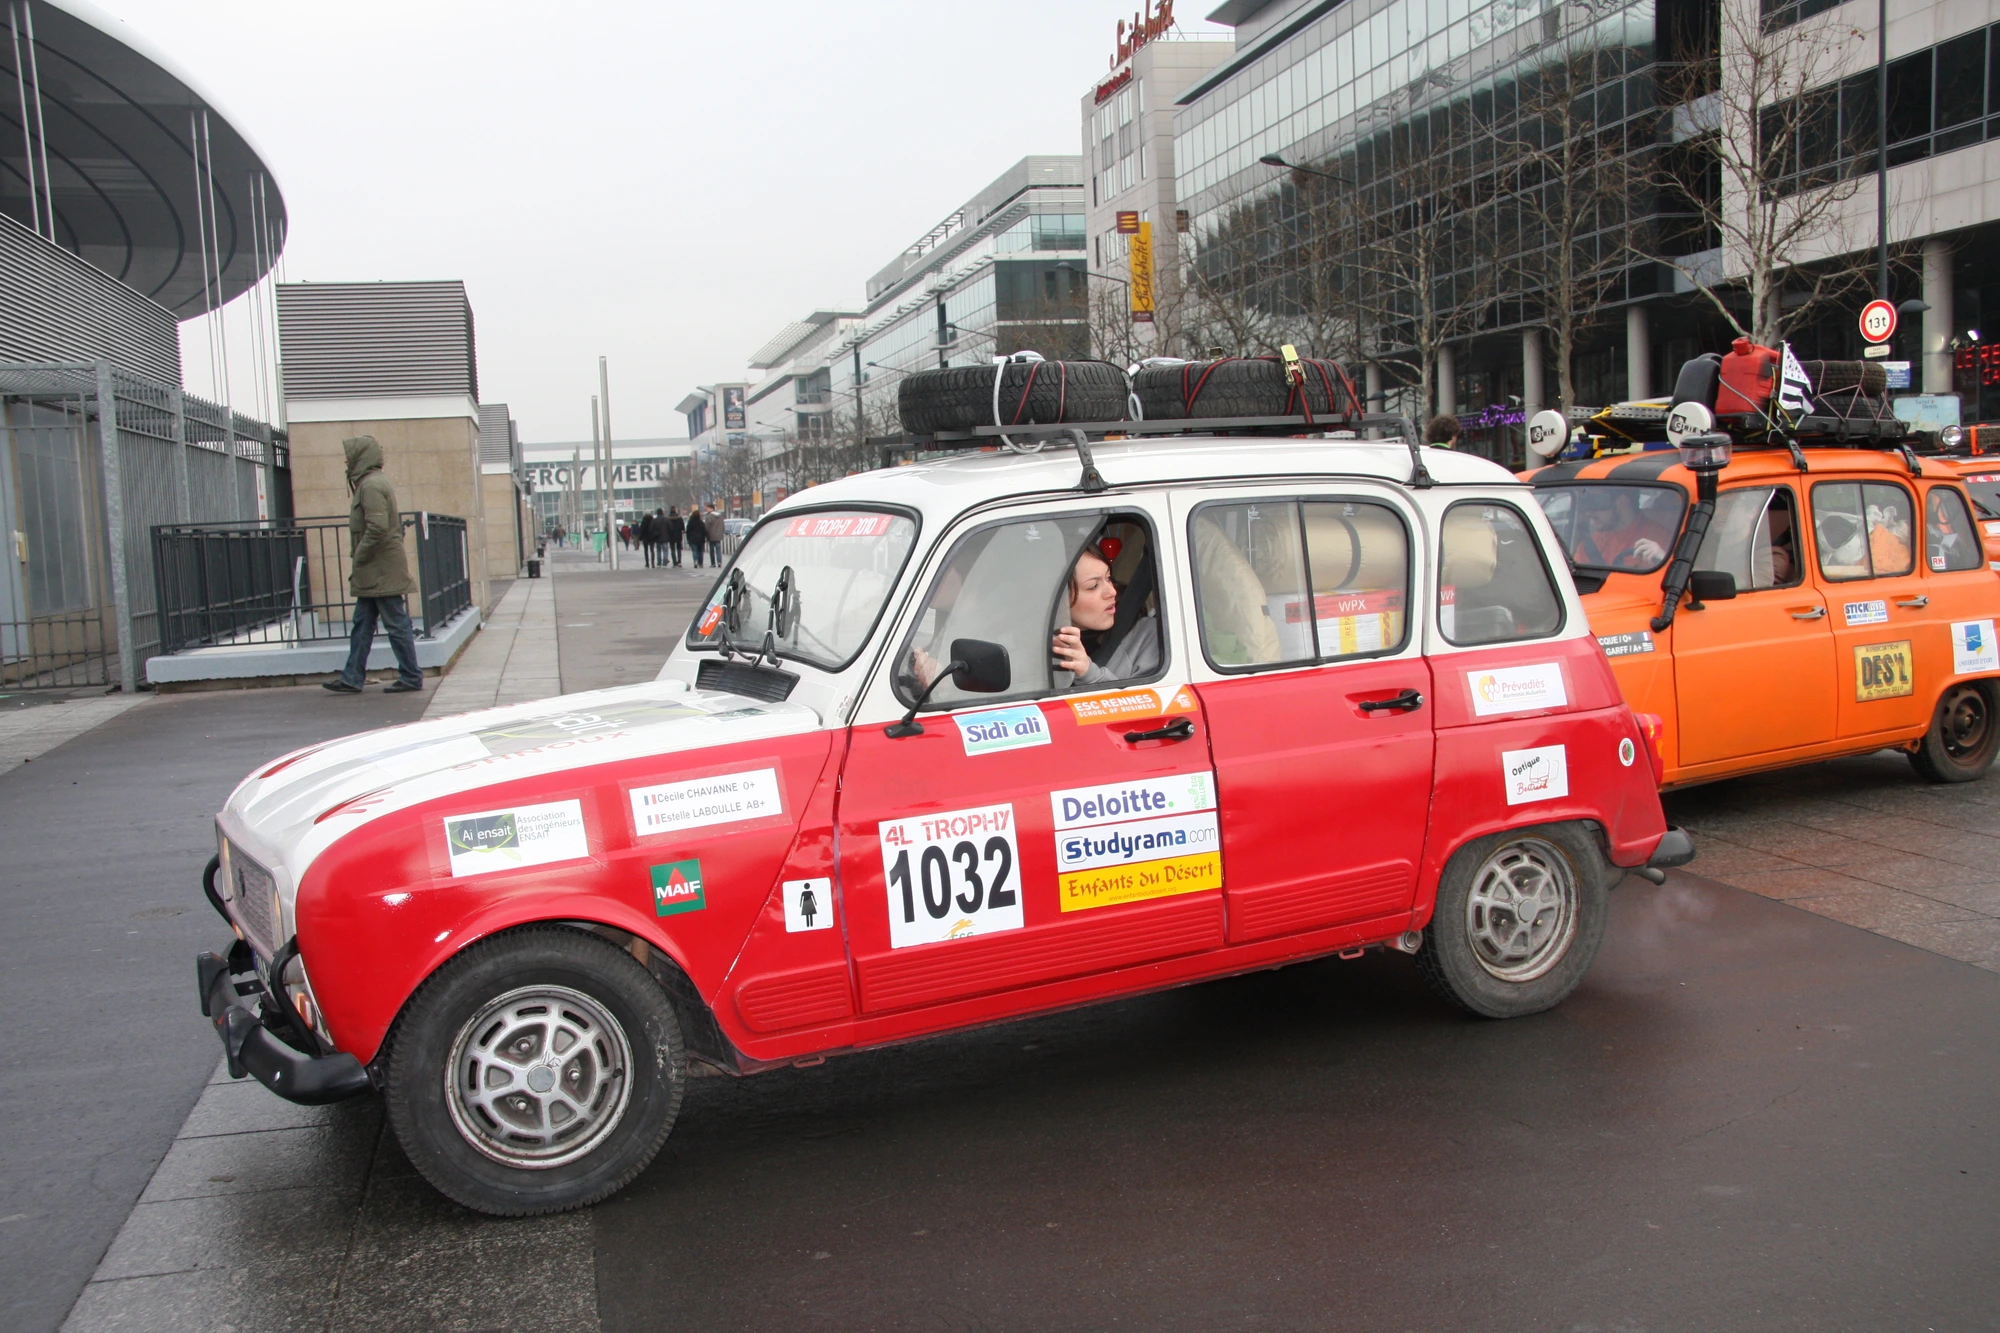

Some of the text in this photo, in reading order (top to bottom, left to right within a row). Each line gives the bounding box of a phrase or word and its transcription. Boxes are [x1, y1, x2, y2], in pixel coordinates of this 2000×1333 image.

[525, 467, 588, 486] EROY
[797, 520, 811, 535] 4L
[812, 519, 854, 535] TROPHY
[851, 517, 879, 535] 2010
[1338, 599, 1367, 613] WPX
[1597, 635, 1619, 646] CQUE
[1605, 645, 1628, 656] GARFF
[1501, 678, 1545, 693] Prévadiès
[1074, 694, 1154, 712] ESC RENNES
[1078, 702, 1157, 718] SCHOOL OF BUSINESS
[966, 717, 1042, 743] Sidi ali
[1511, 755, 1541, 776] Optique
[657, 791, 685, 803] Cécile
[687, 782, 738, 799] CHAVANNE
[516, 811, 566, 825] Association
[661, 799, 766, 823] Estelle LABOULLE AB+
[462, 824, 513, 842] Ai ensait
[518, 818, 581, 834] des ingénieurs
[885, 810, 1010, 846] 4L TROPHY
[519, 830, 550, 843] ENSAIT
[889, 835, 1016, 924] 1032
[1068, 861, 1213, 898] Enfants du Désert
[656, 880, 701, 899] MAIF
